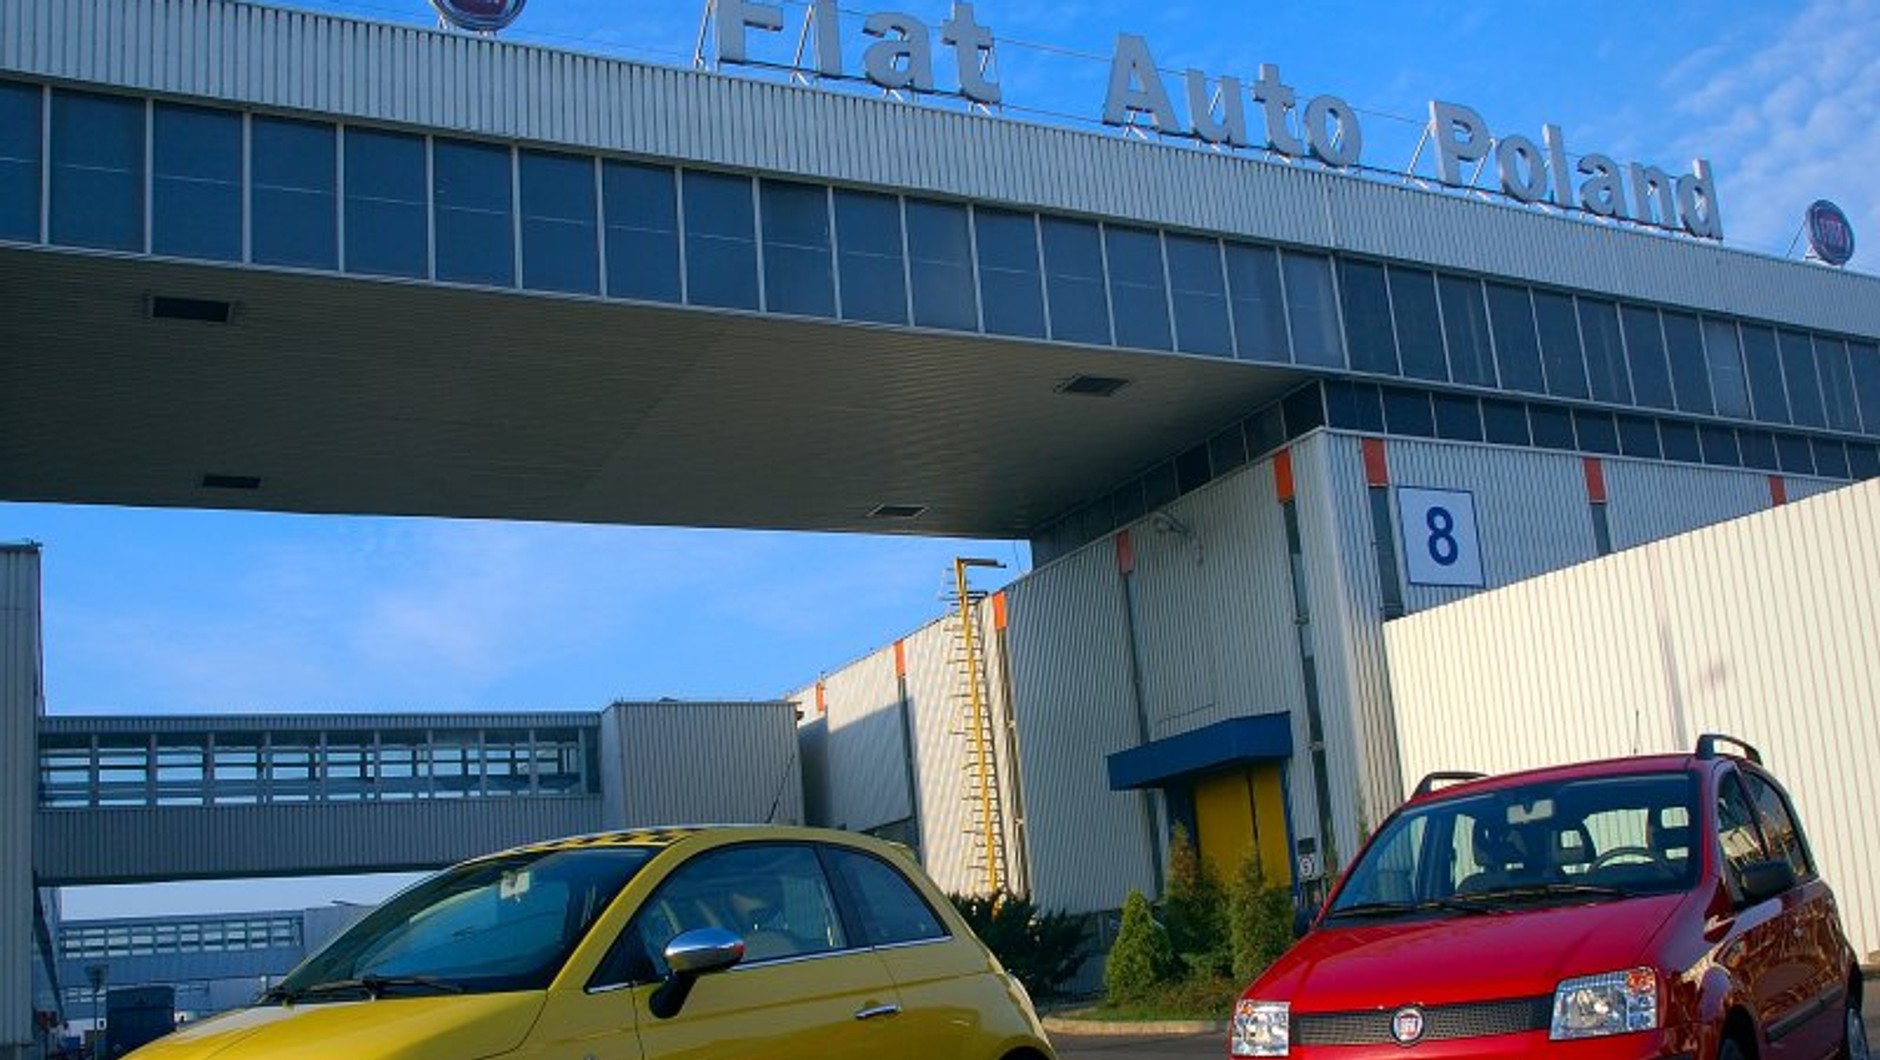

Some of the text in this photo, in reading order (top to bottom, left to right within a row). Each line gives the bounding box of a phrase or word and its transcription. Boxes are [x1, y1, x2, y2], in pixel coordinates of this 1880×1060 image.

[1102, 33, 1361, 168] Auto
[1429, 100, 1724, 240] Poland
[1426, 506, 1458, 566] 8
